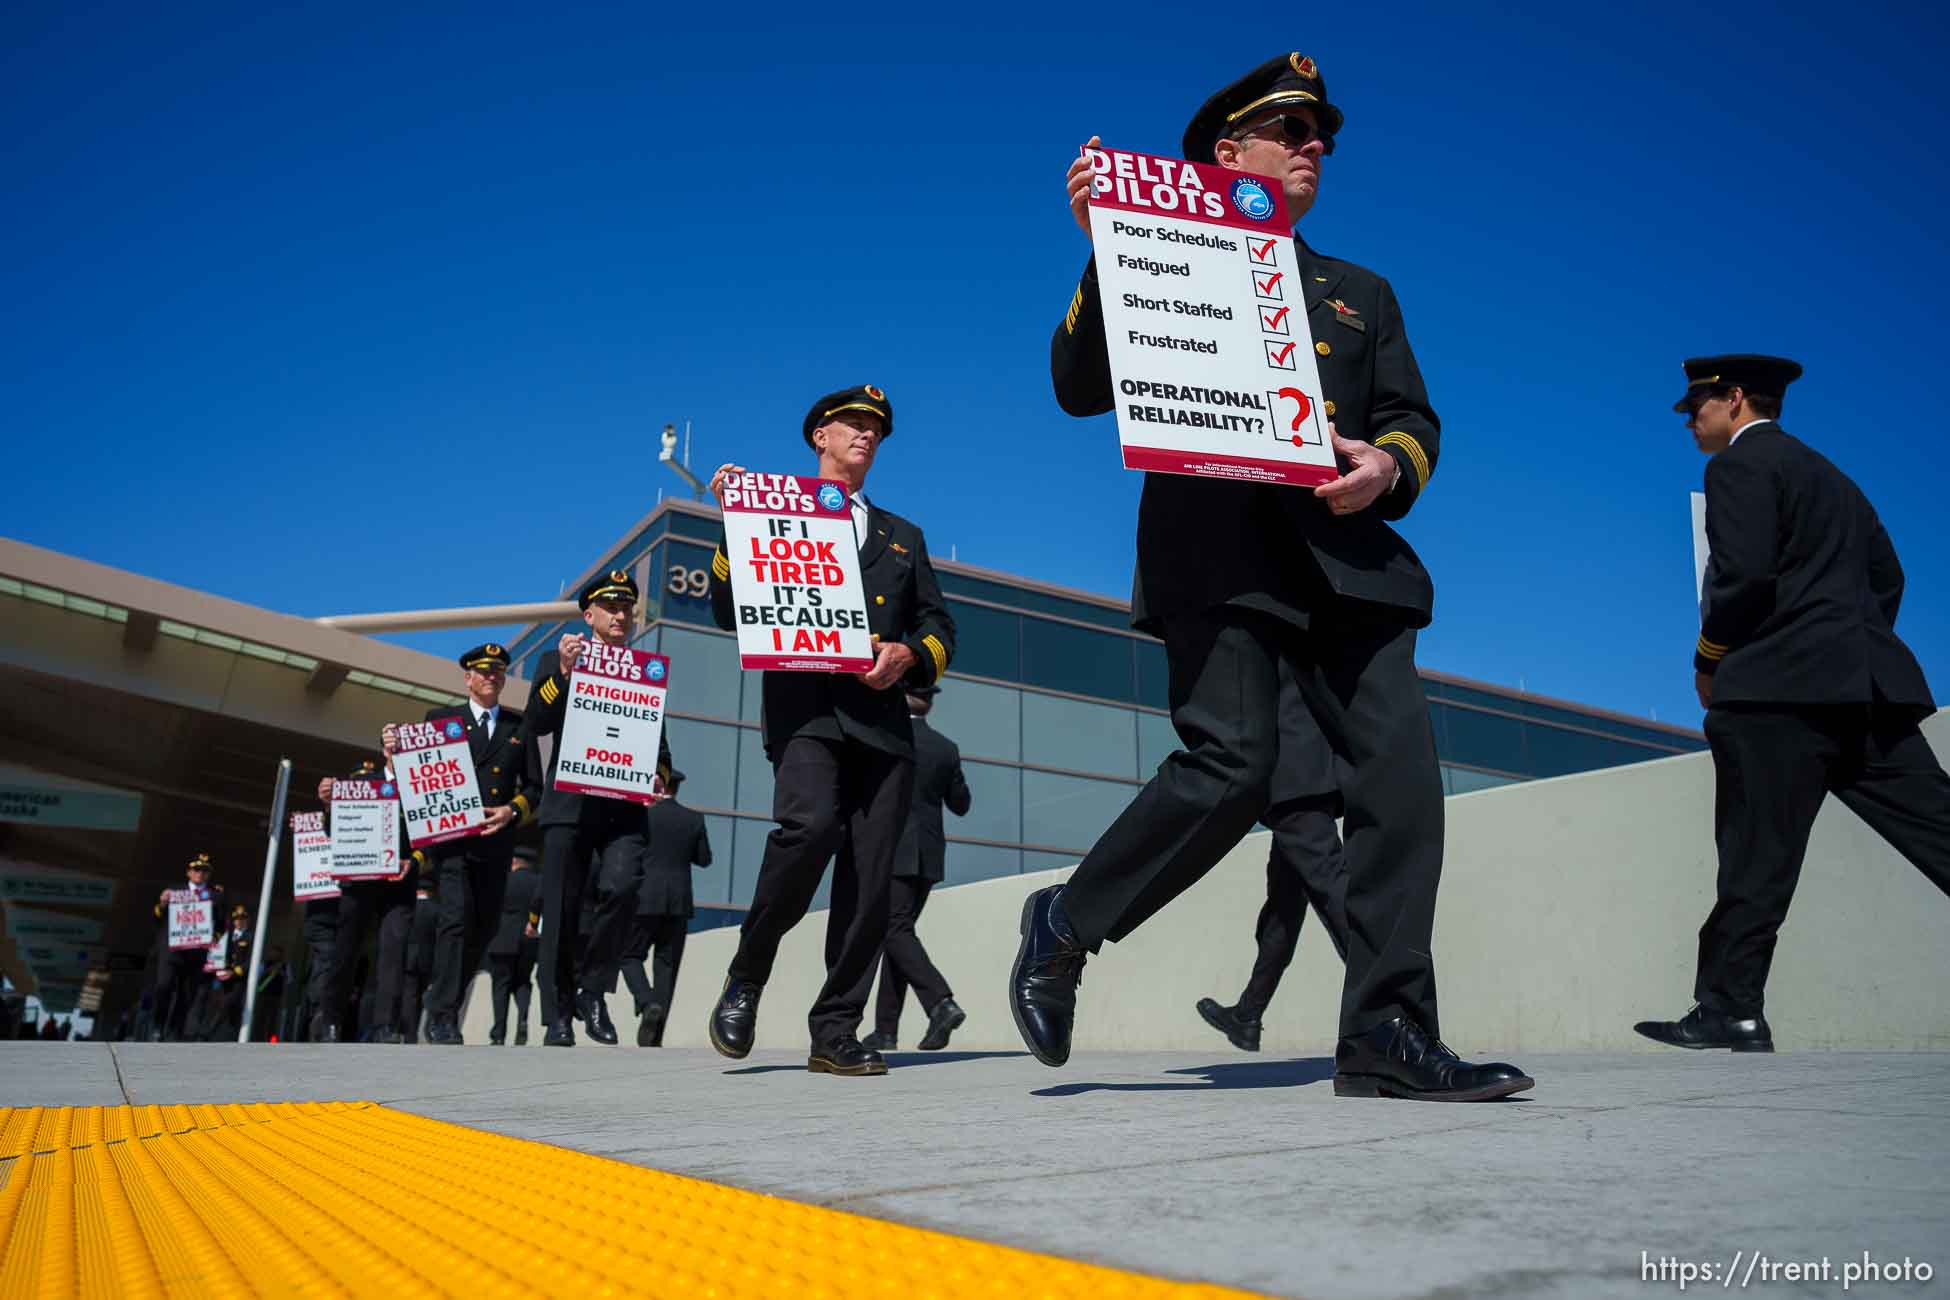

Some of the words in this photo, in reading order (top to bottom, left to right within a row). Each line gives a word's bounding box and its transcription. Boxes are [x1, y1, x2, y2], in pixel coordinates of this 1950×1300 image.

[1086, 148, 1204, 190] DELTA
[1090, 175, 1225, 218] PILOTS
[1112, 221, 1153, 238] Poor
[1156, 227, 1238, 252] Schedules
[1117, 254, 1190, 276] Fatigued
[1123, 293, 1170, 313] Short
[1173, 300, 1233, 321] Staffed
[1128, 330, 1218, 354] Frustrated
[1120, 379, 1266, 411] OPERATIONAL
[1128, 404, 1265, 434] RELIABILITY?
[1278, 387, 1311, 447] ?
[724, 472, 801, 494] DELTA
[724, 489, 815, 512] PILOTS
[768, 518, 791, 537] IF
[800, 520, 808, 538] I
[751, 537, 838, 564] LOOK
[668, 564, 711, 599] 39
[749, 560, 844, 586] TIRED
[773, 585, 822, 606] IT'S
[739, 605, 866, 629] BECAUSE
[580, 640, 634, 665] DELTA
[772, 628, 782, 651] I
[792, 629, 842, 653] AM
[575, 655, 641, 680] PILOTS
[575, 682, 660, 708] FATIGUING
[573, 697, 658, 722] SCHEDULES
[394, 721, 436, 738] ELTA
[399, 731, 446, 751] ILOTS
[606, 726, 620, 738] =
[418, 751, 431, 764] IF
[437, 749, 442, 761] I
[586, 747, 633, 767] POOR
[409, 759, 461, 780] LOOK
[560, 760, 653, 785] RELIABILITY
[332, 780, 371, 793] DELTA
[332, 788, 378, 799] PILOTS
[409, 773, 465, 795] TIRED
[407, 796, 481, 822] BECAUSE
[424, 789, 454, 805] IT'S
[294, 812, 324, 823] DELT
[294, 822, 323, 833] PILO
[427, 820, 433, 833] I
[439, 812, 467, 831] AM
